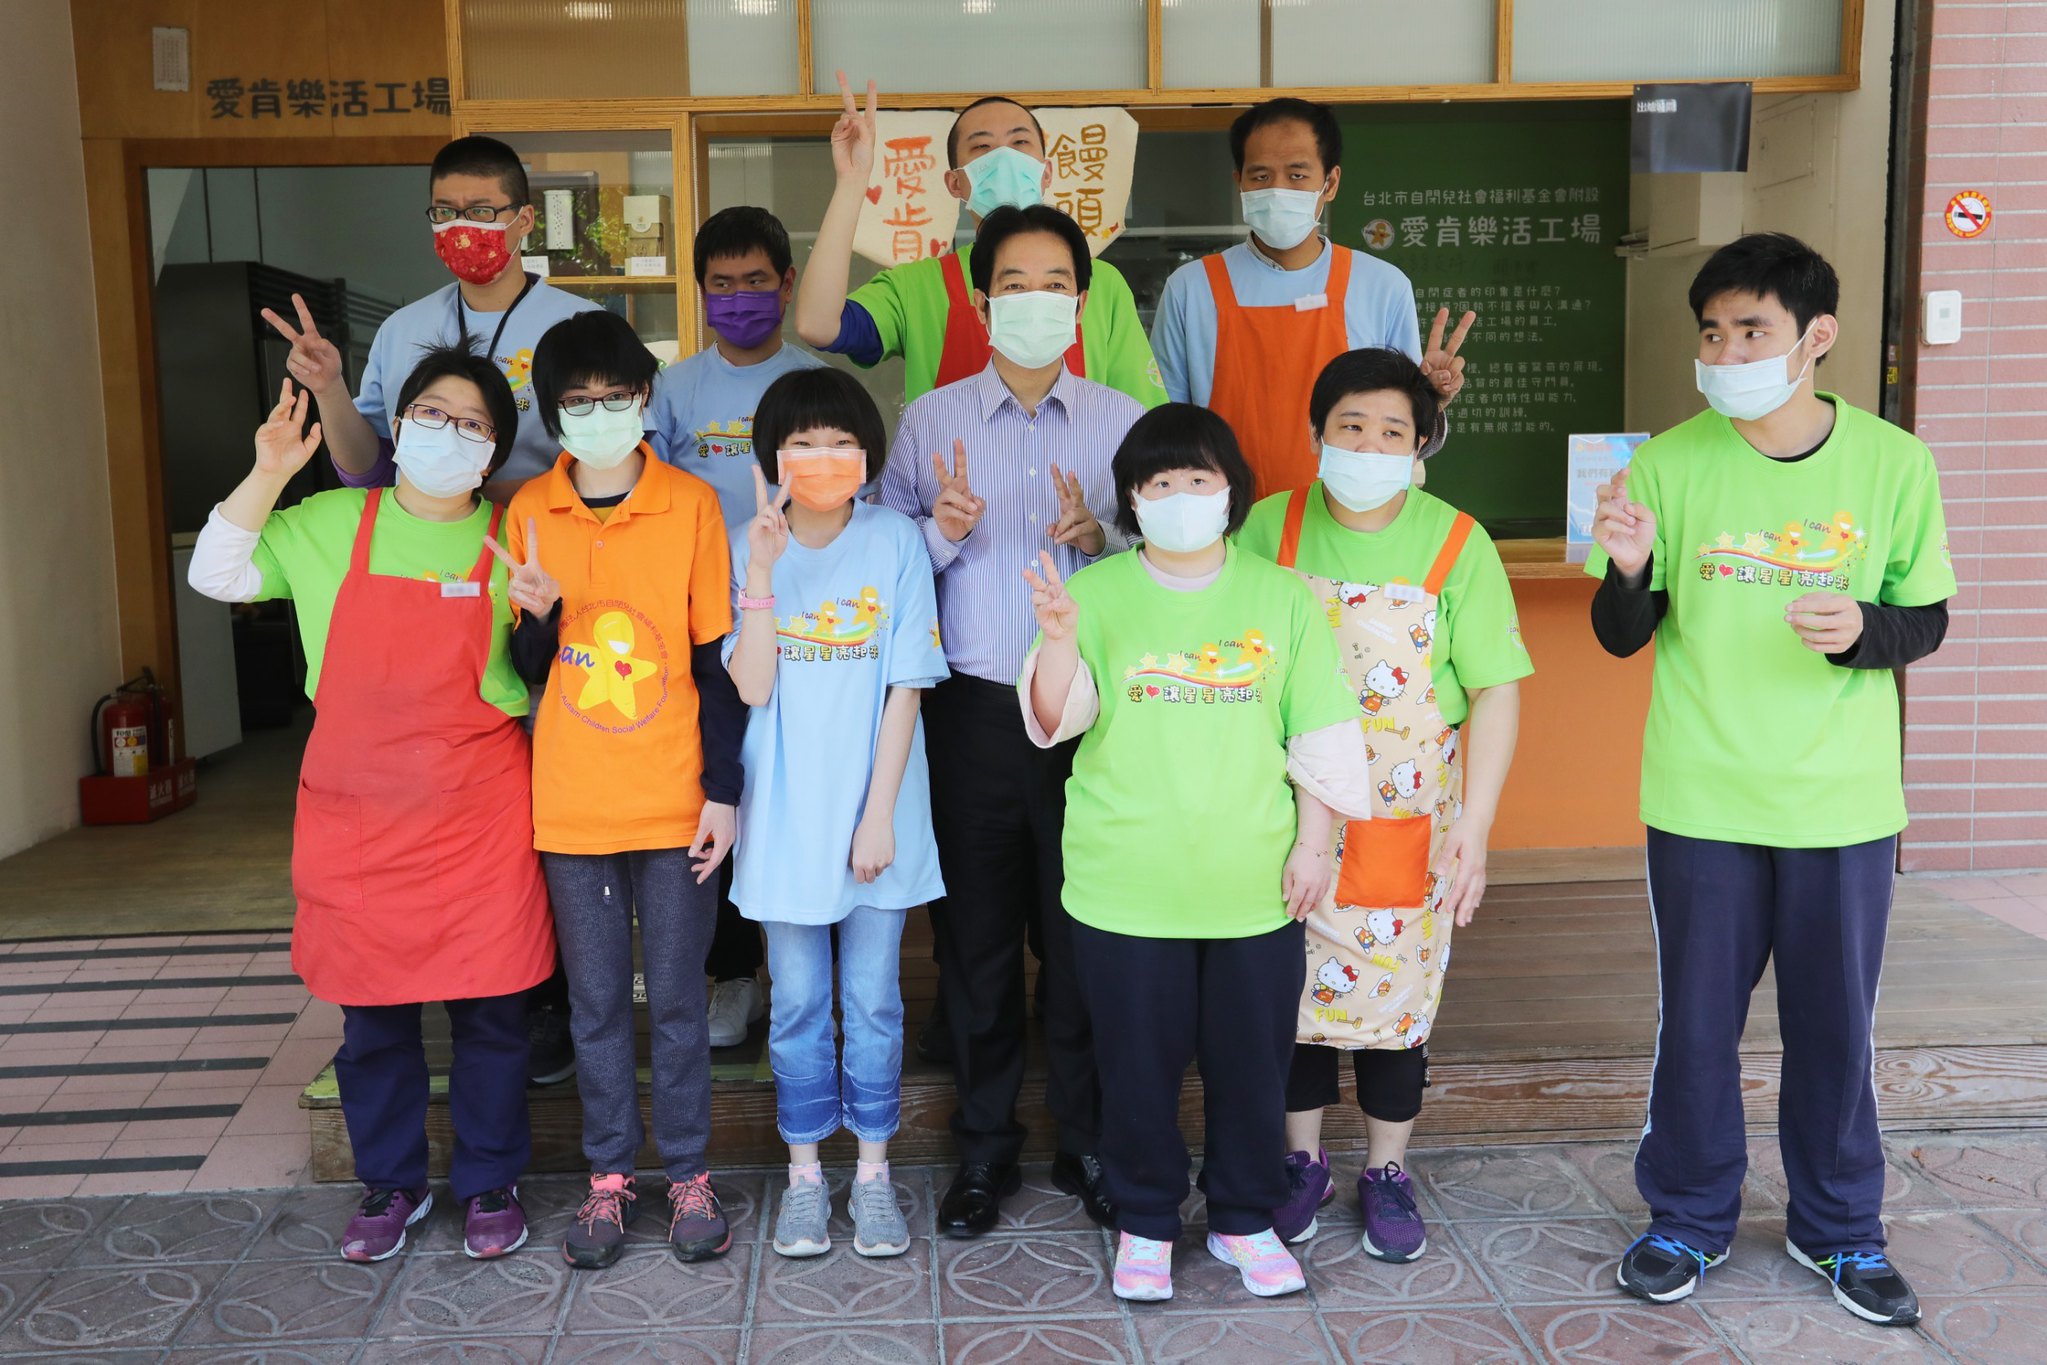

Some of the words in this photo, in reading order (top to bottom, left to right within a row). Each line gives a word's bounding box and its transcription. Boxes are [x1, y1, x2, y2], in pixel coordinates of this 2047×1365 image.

[206, 77, 451, 119] 愛肯樂活工場
[1049, 123, 1109, 237] 饅頭
[1363, 187, 1600, 206] 台北市自閉兒社會福利基金會附設
[1400, 214, 1601, 248] 愛肯樂活工場
[1809, 521, 1832, 534] can
[1764, 531, 1783, 543] can
[840, 599, 860, 609] can
[1223, 640, 1245, 649] can
[559, 646, 595, 668] an
[561, 694, 581, 718] Autism
[581, 714, 610, 733] Children
[612, 724, 636, 734] Social
[636, 707, 660, 728] Welfare
[1361, 716, 1396, 734] FUN
[1314, 1007, 1347, 1024] FUN
